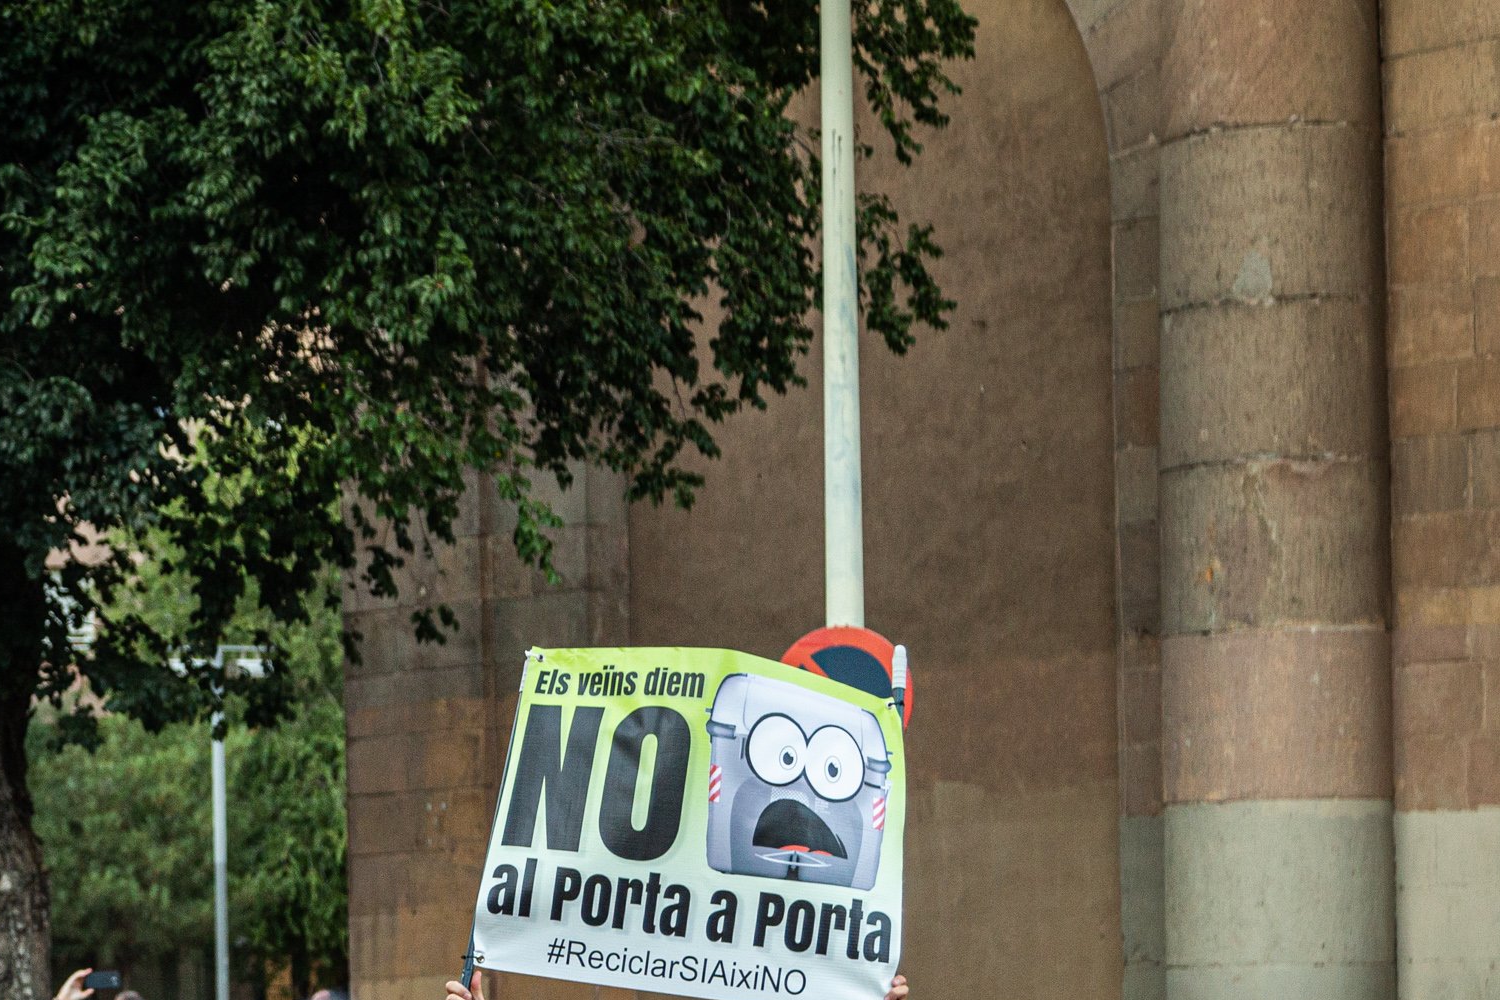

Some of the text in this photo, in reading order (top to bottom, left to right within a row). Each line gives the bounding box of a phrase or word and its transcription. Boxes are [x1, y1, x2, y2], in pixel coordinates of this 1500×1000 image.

[535, 665, 705, 698] Els veïns diem
[501, 703, 692, 862] NO
[487, 858, 538, 918] al
[706, 890, 738, 944] a
[547, 938, 807, 995] #ReciclarSIAixiNO
